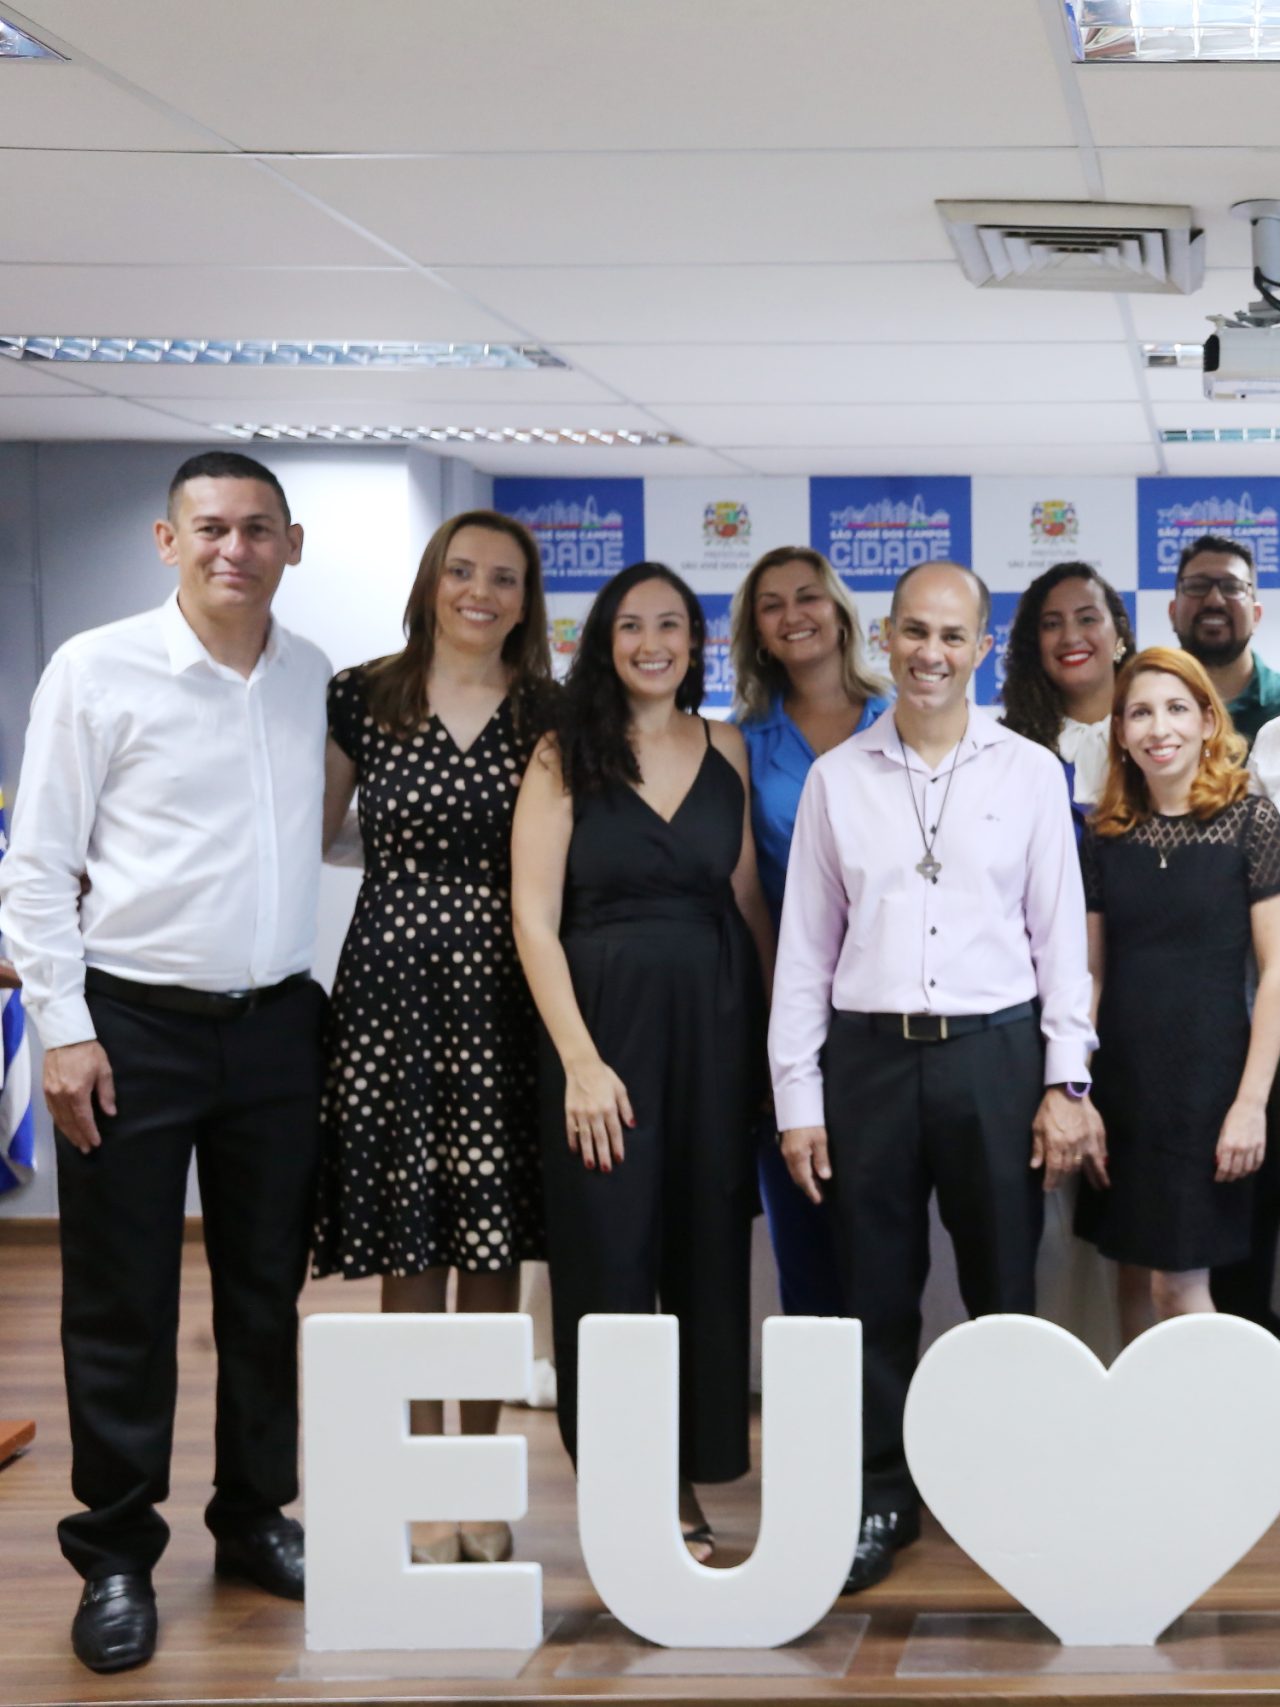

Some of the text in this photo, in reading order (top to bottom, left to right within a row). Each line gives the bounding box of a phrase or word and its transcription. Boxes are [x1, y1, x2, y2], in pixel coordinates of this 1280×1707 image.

[829, 527, 951, 540] SÃO JOSÉ DOS CAMPOS
[1157, 525, 1180, 537] SÃO
[1233, 527, 1278, 537] CAMPOS
[540, 541, 624, 569] DADE
[829, 540, 952, 567] CIDADE
[304, 1313, 863, 1651] EU
